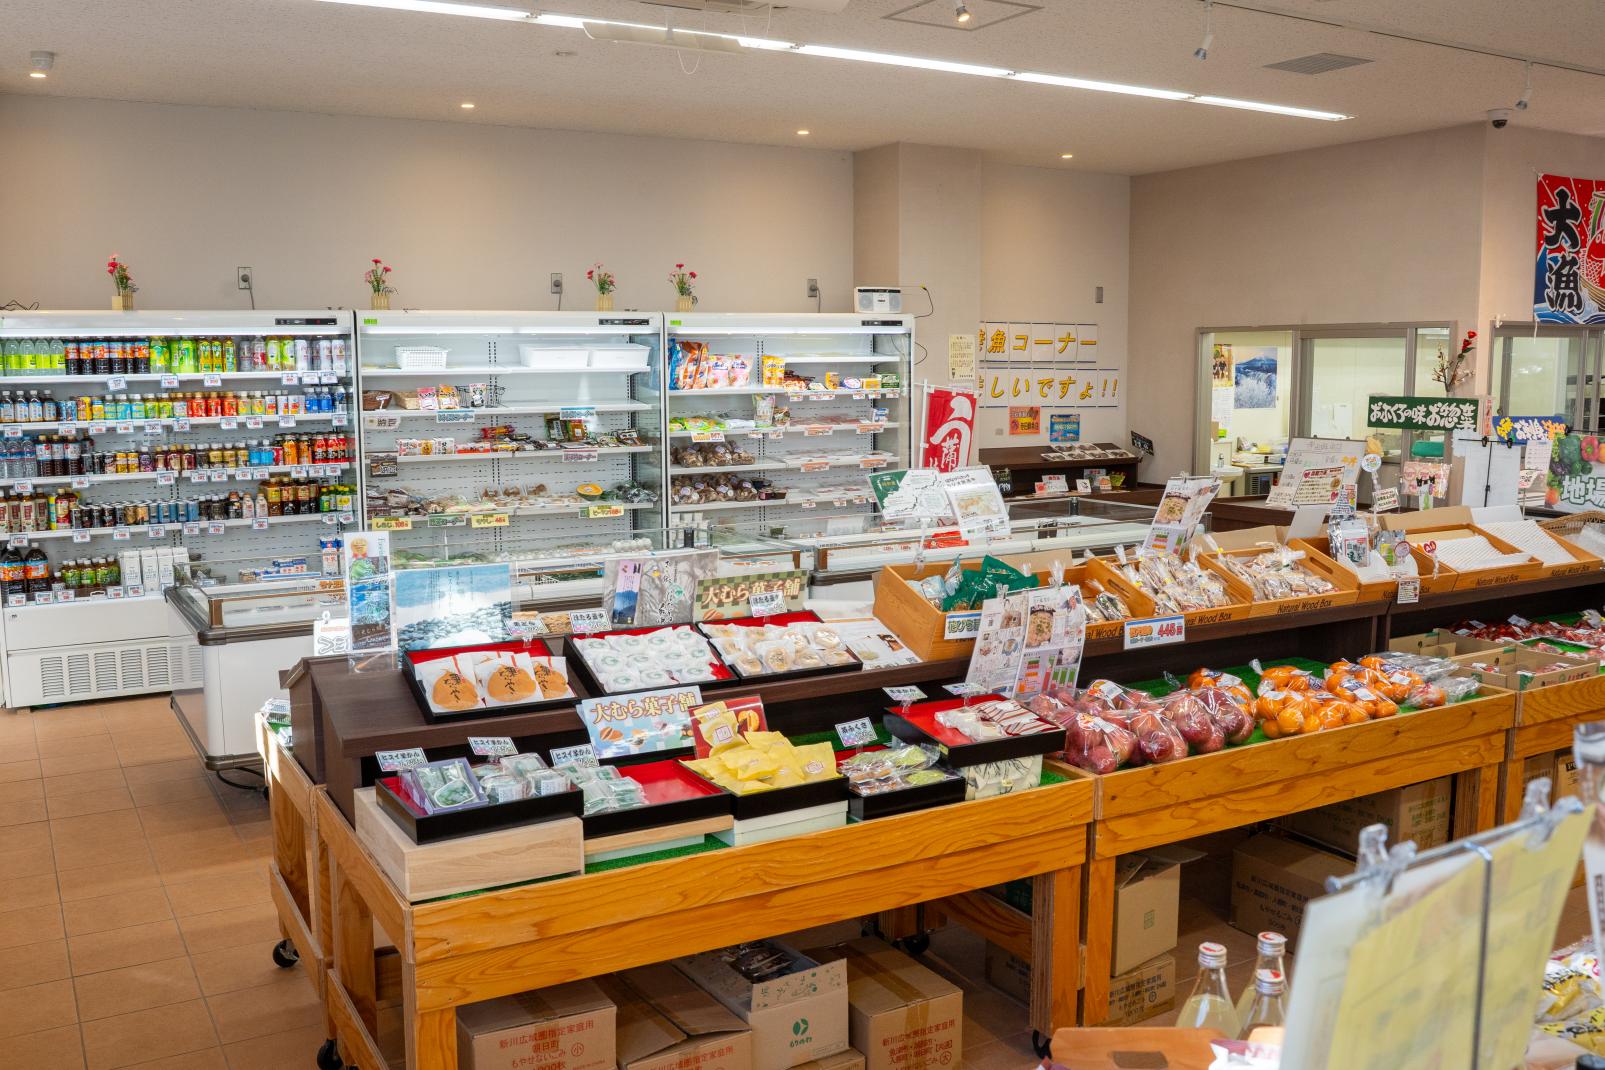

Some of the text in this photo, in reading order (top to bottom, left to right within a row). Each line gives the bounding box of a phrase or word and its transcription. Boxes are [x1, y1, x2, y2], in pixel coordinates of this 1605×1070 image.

[1543, 187, 1584, 313] 大漁
[1198, 611, 1232, 624] Wood Box
[591, 691, 697, 725] 大むら菓子舗
